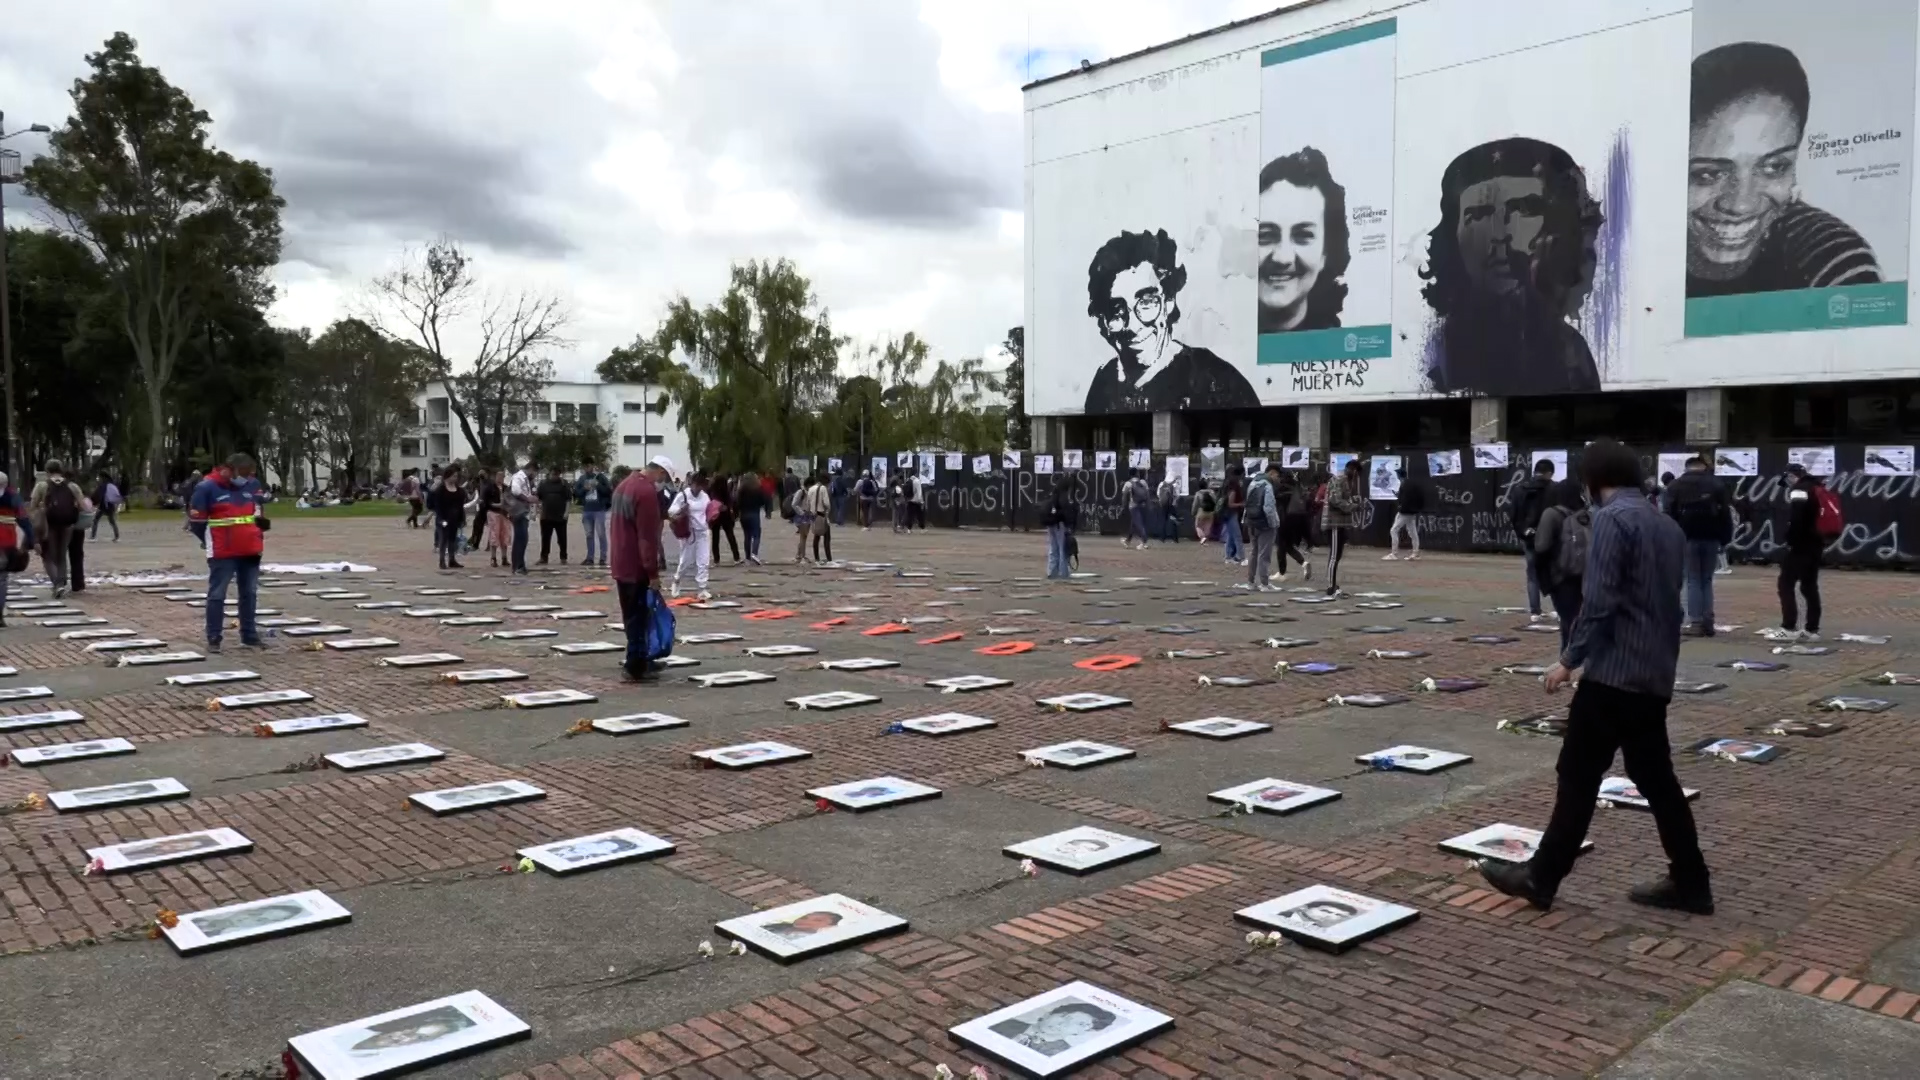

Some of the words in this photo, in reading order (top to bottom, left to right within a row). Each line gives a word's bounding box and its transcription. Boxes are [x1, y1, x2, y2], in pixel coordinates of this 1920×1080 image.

[1807, 138, 1849, 152] Zapata
[1852, 128, 1902, 145] Olivella
[1290, 358, 1369, 376] NUESTRAS
[1292, 371, 1364, 392] MUERTAS
